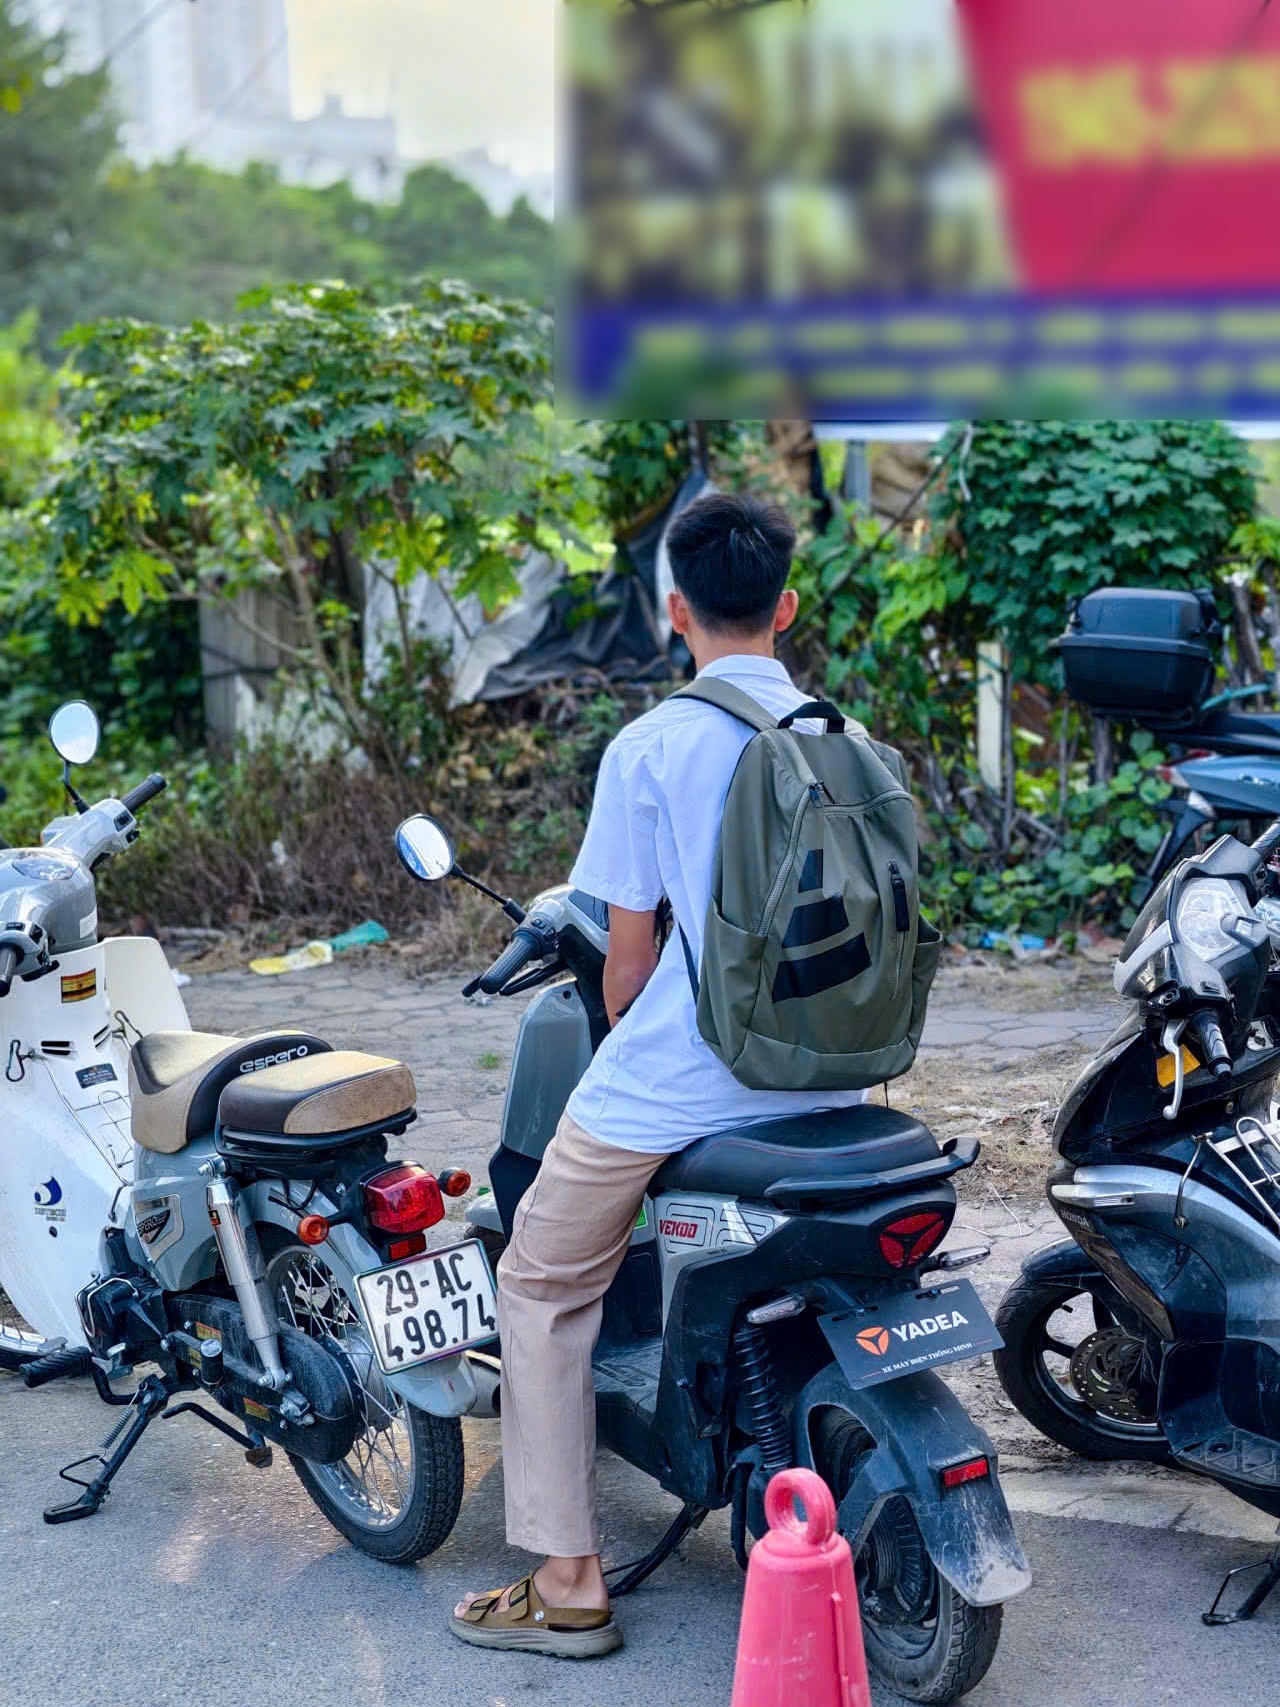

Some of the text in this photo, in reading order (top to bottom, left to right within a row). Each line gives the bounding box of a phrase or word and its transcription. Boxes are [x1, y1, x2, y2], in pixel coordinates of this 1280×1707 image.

[1060, 1207, 1090, 1229] HONDA
[377, 1253, 472, 1316] 29-AC
[383, 1293, 496, 1362] 498.74
[891, 1310, 969, 1342] YADEA
[882, 1366, 893, 1374] XE
[954, 1342, 973, 1351] MINH
